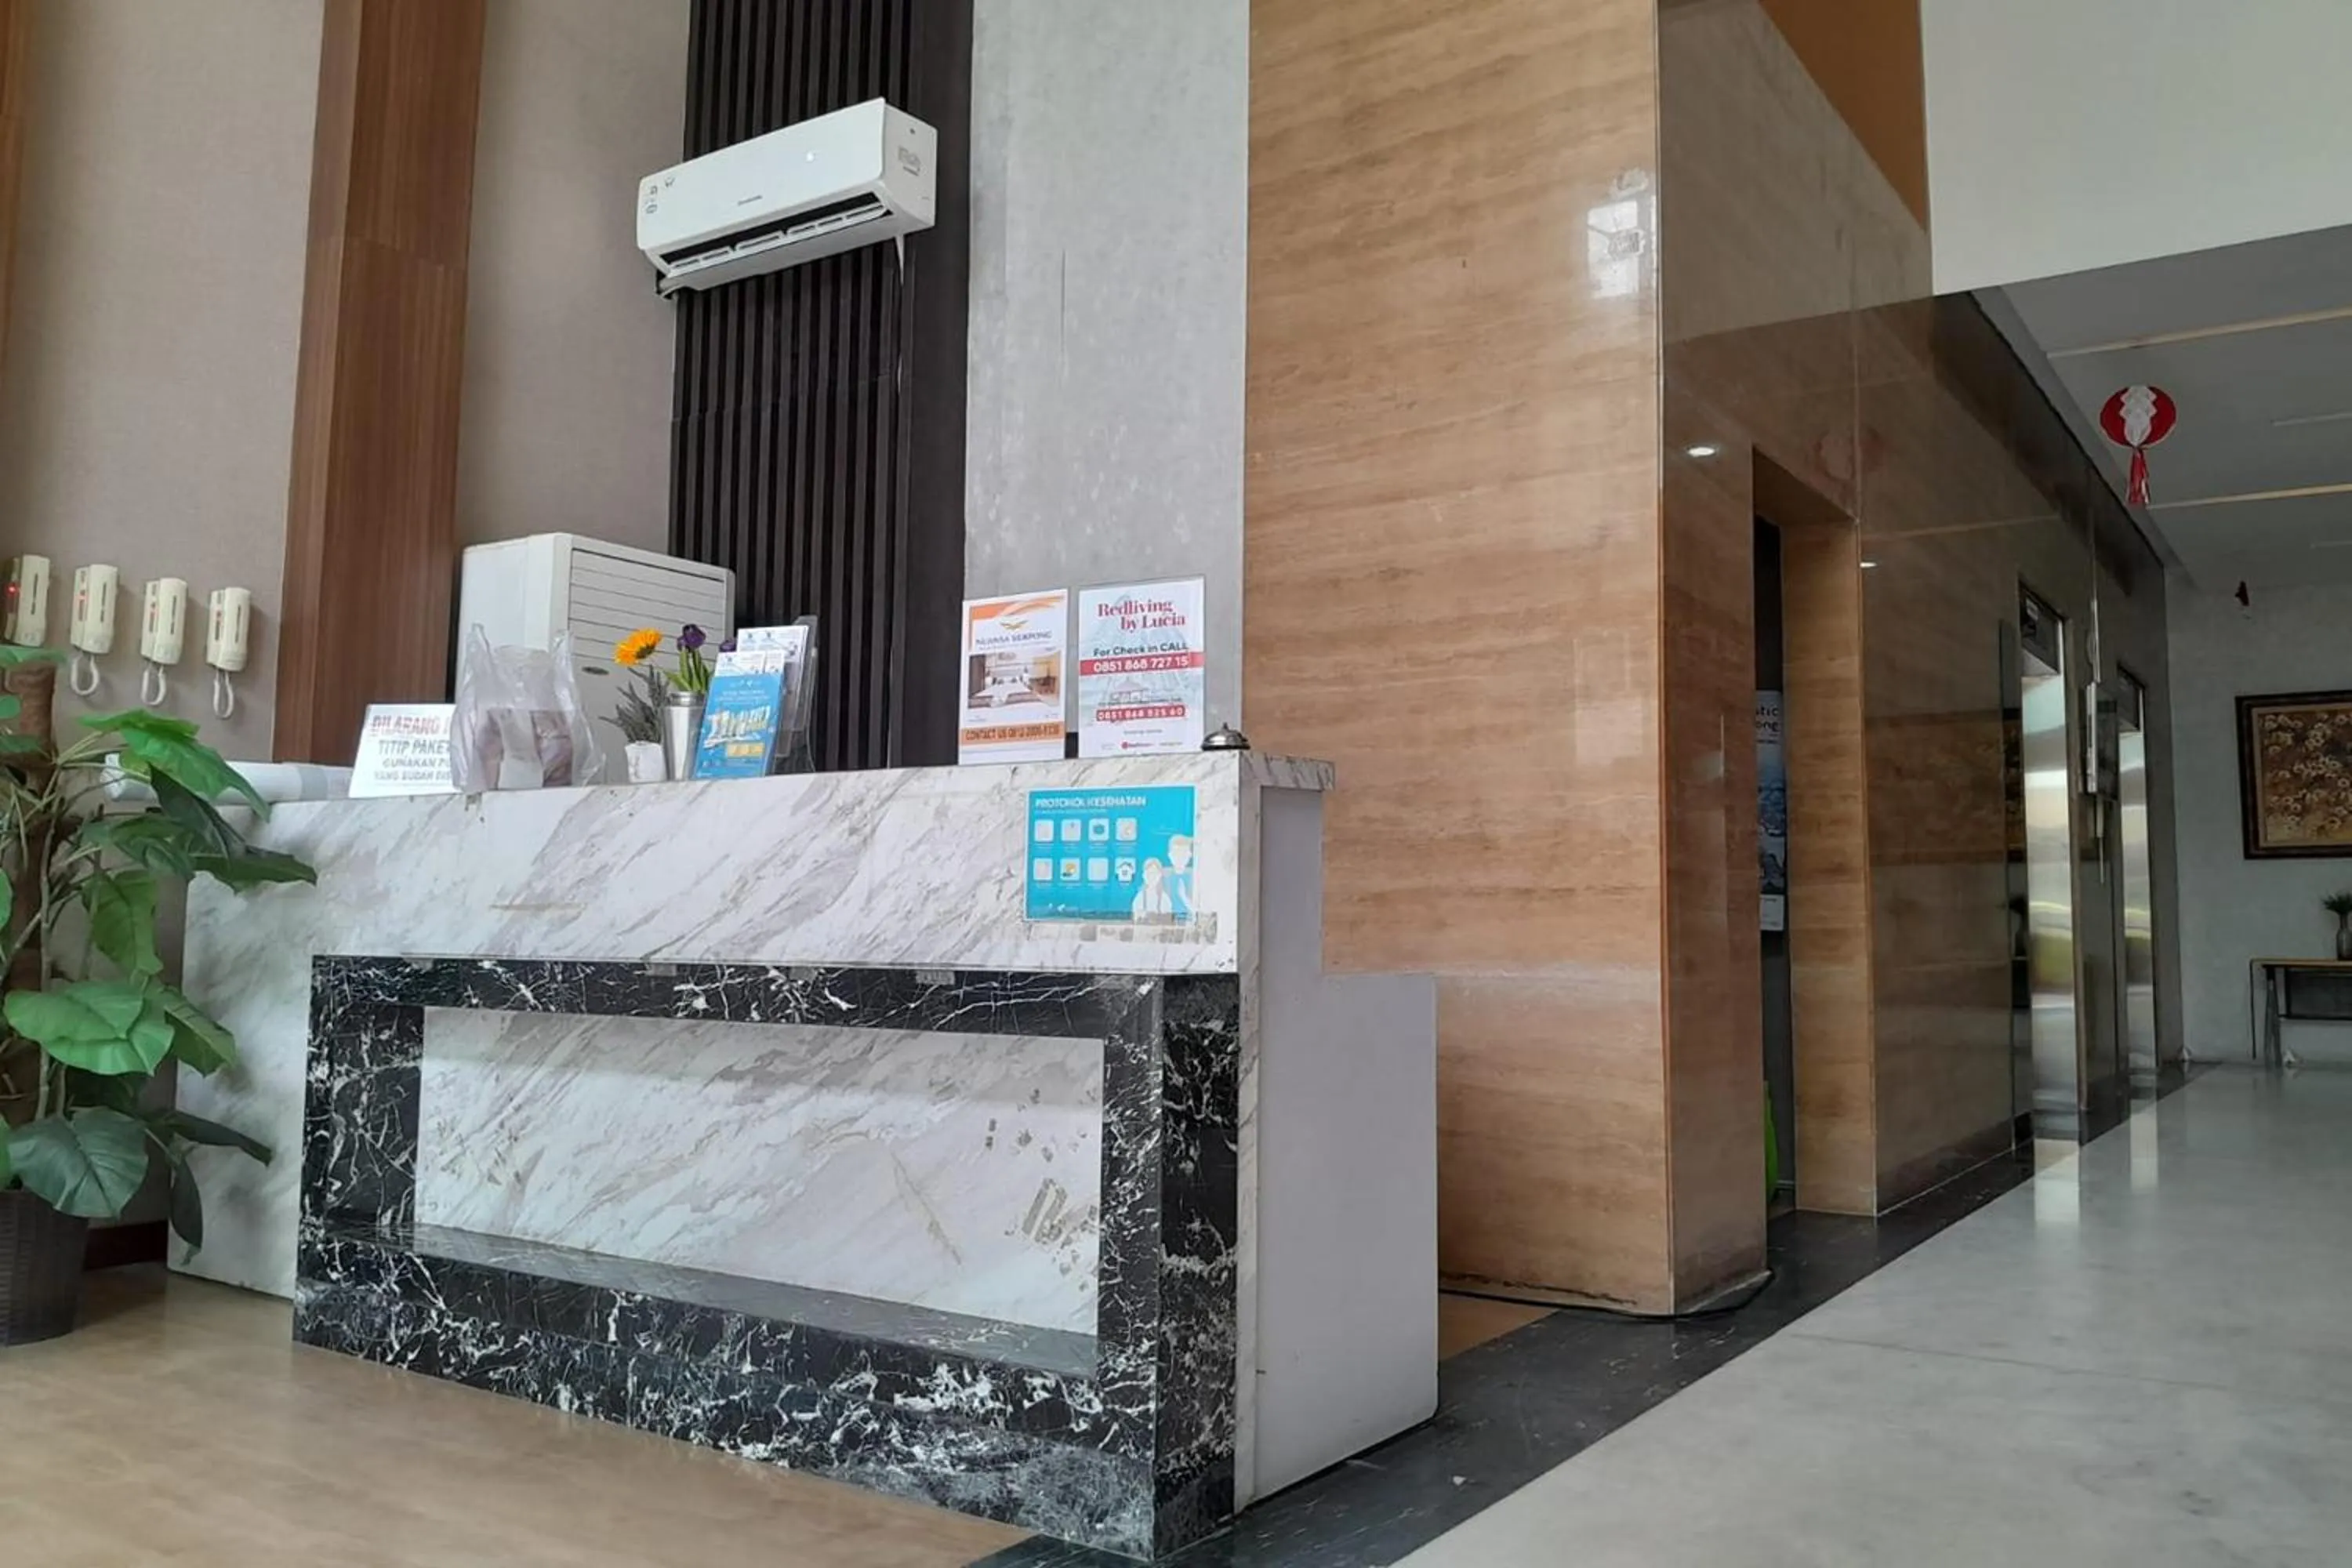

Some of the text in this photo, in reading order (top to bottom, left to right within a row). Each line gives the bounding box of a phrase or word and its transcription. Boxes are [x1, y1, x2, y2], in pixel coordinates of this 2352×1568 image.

[1098, 599, 1173, 616] Redliving
[1120, 612, 1185, 633] by Lucia
[1094, 648, 1110, 657] For
[1113, 644, 1145, 655] Check
[1160, 642, 1189, 652] CALL
[1094, 661, 1122, 673] 0851
[1151, 657, 1173, 669] 727
[1175, 655, 1189, 666] 15
[379, 739, 410, 755] TITIP
